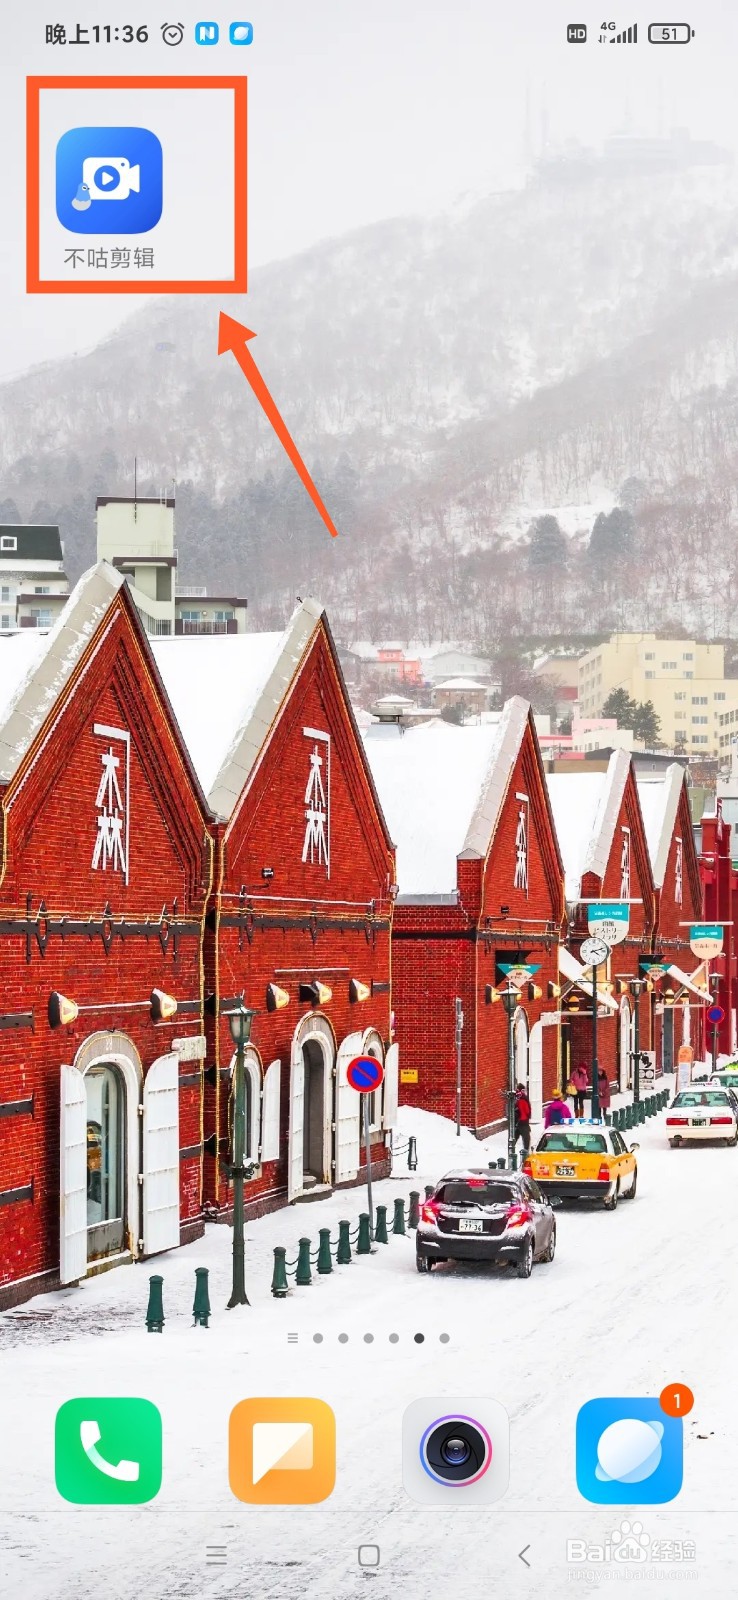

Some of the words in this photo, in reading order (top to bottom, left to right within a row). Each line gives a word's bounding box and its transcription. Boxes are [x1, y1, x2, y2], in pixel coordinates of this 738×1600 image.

[600, 21, 616, 31] 4G
[45, 23, 149, 45] 晚上11:36
[568, 28, 586, 39] HD
[661, 28, 677, 41] 51
[63, 246, 155, 269] 不咕剪辑
[673, 1393, 681, 1409] 1
